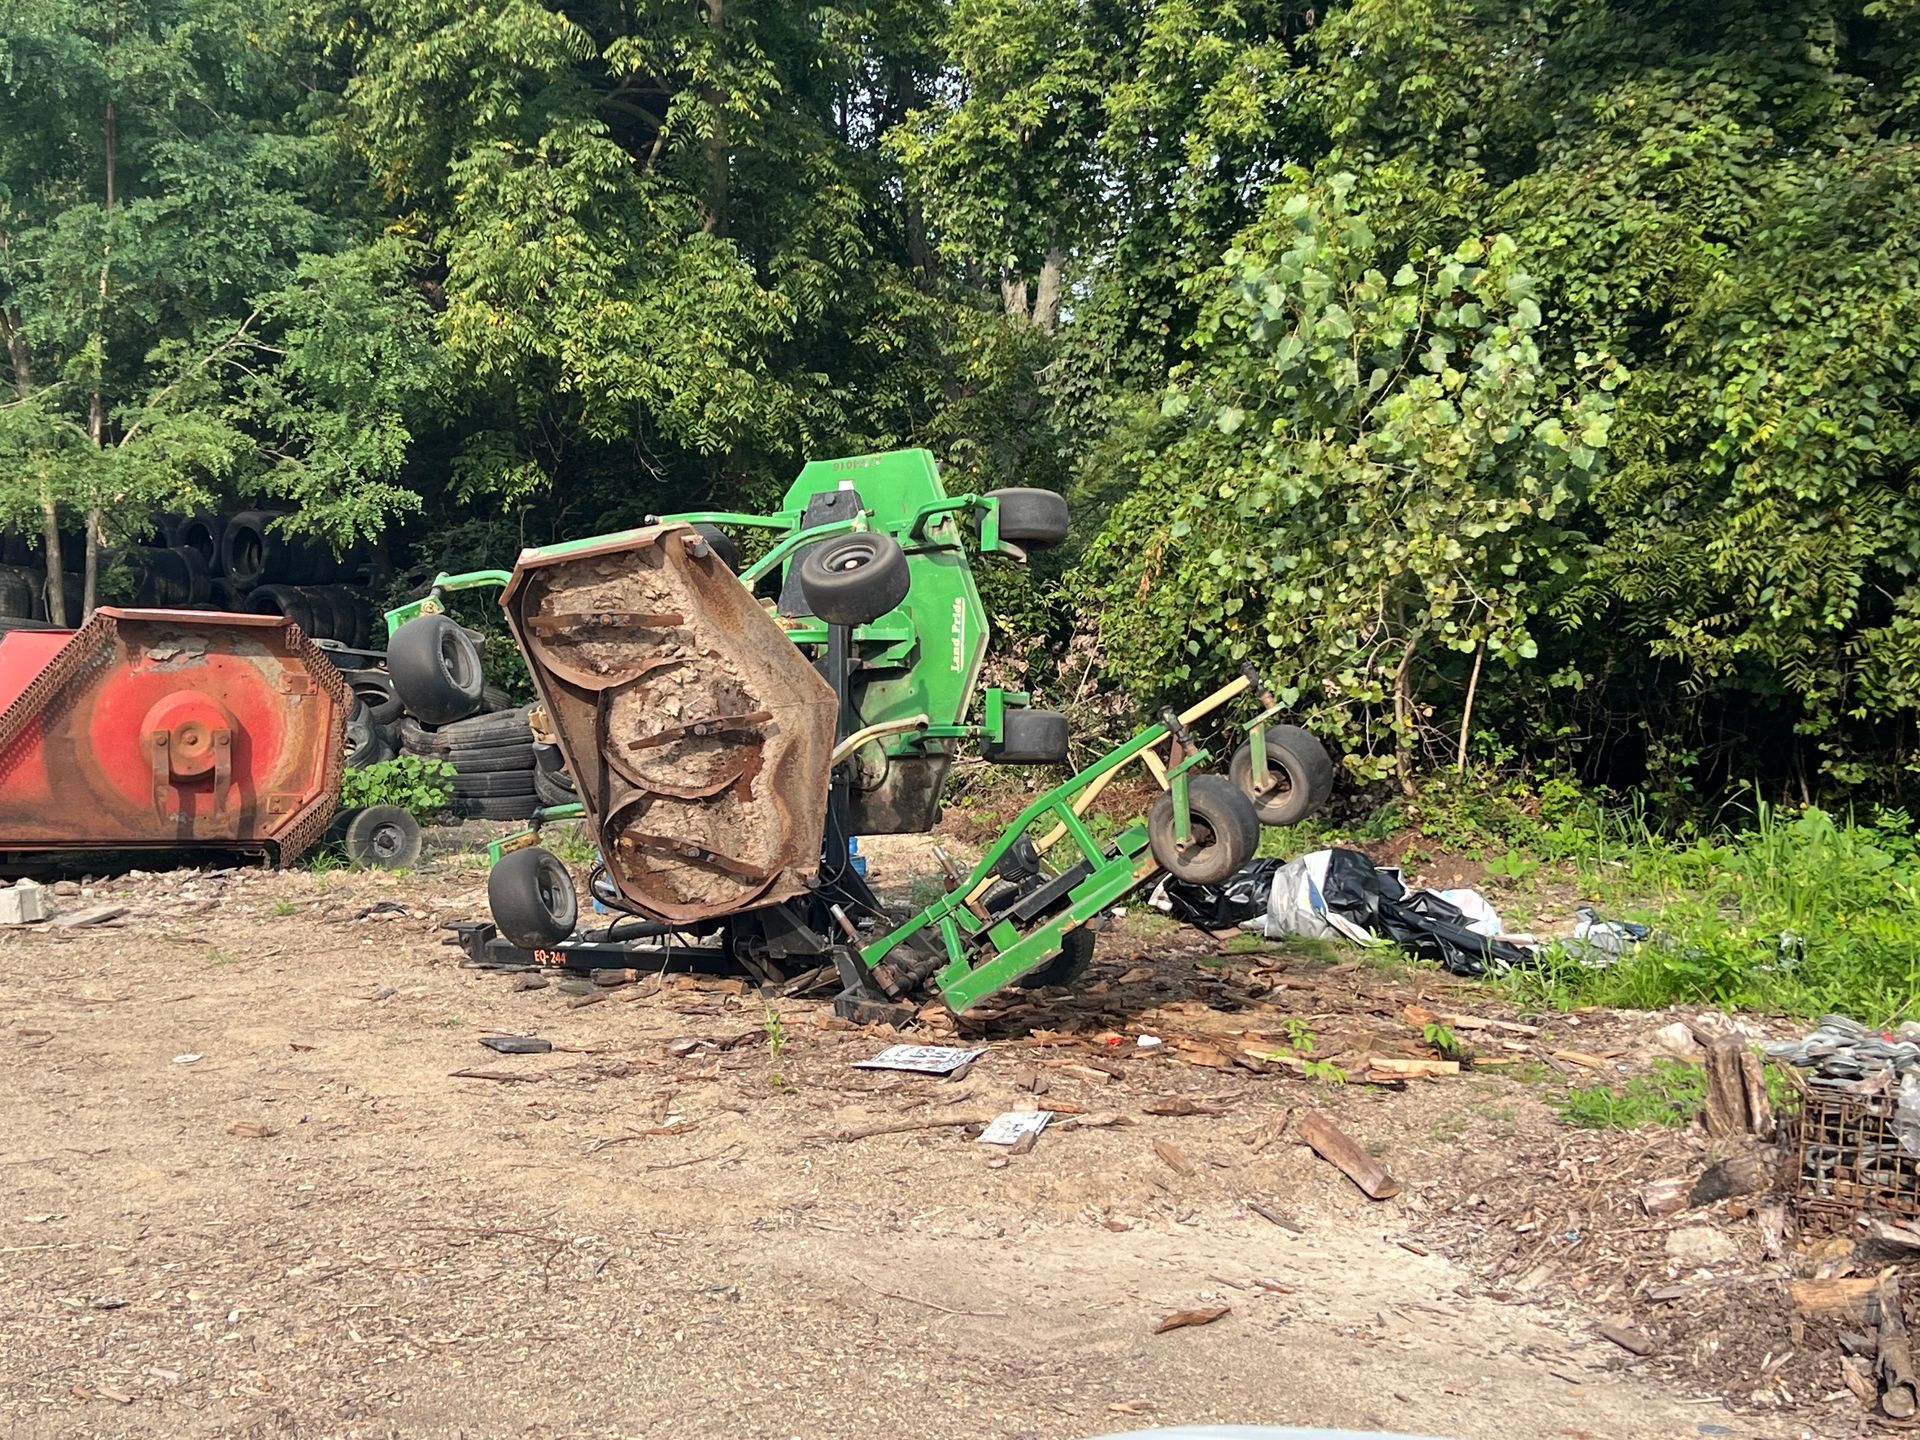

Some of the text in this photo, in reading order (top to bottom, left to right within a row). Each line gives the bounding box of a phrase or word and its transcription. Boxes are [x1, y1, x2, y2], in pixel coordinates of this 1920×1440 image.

[951, 597, 962, 672] Land Pride
[533, 949, 567, 965] EQ-244
